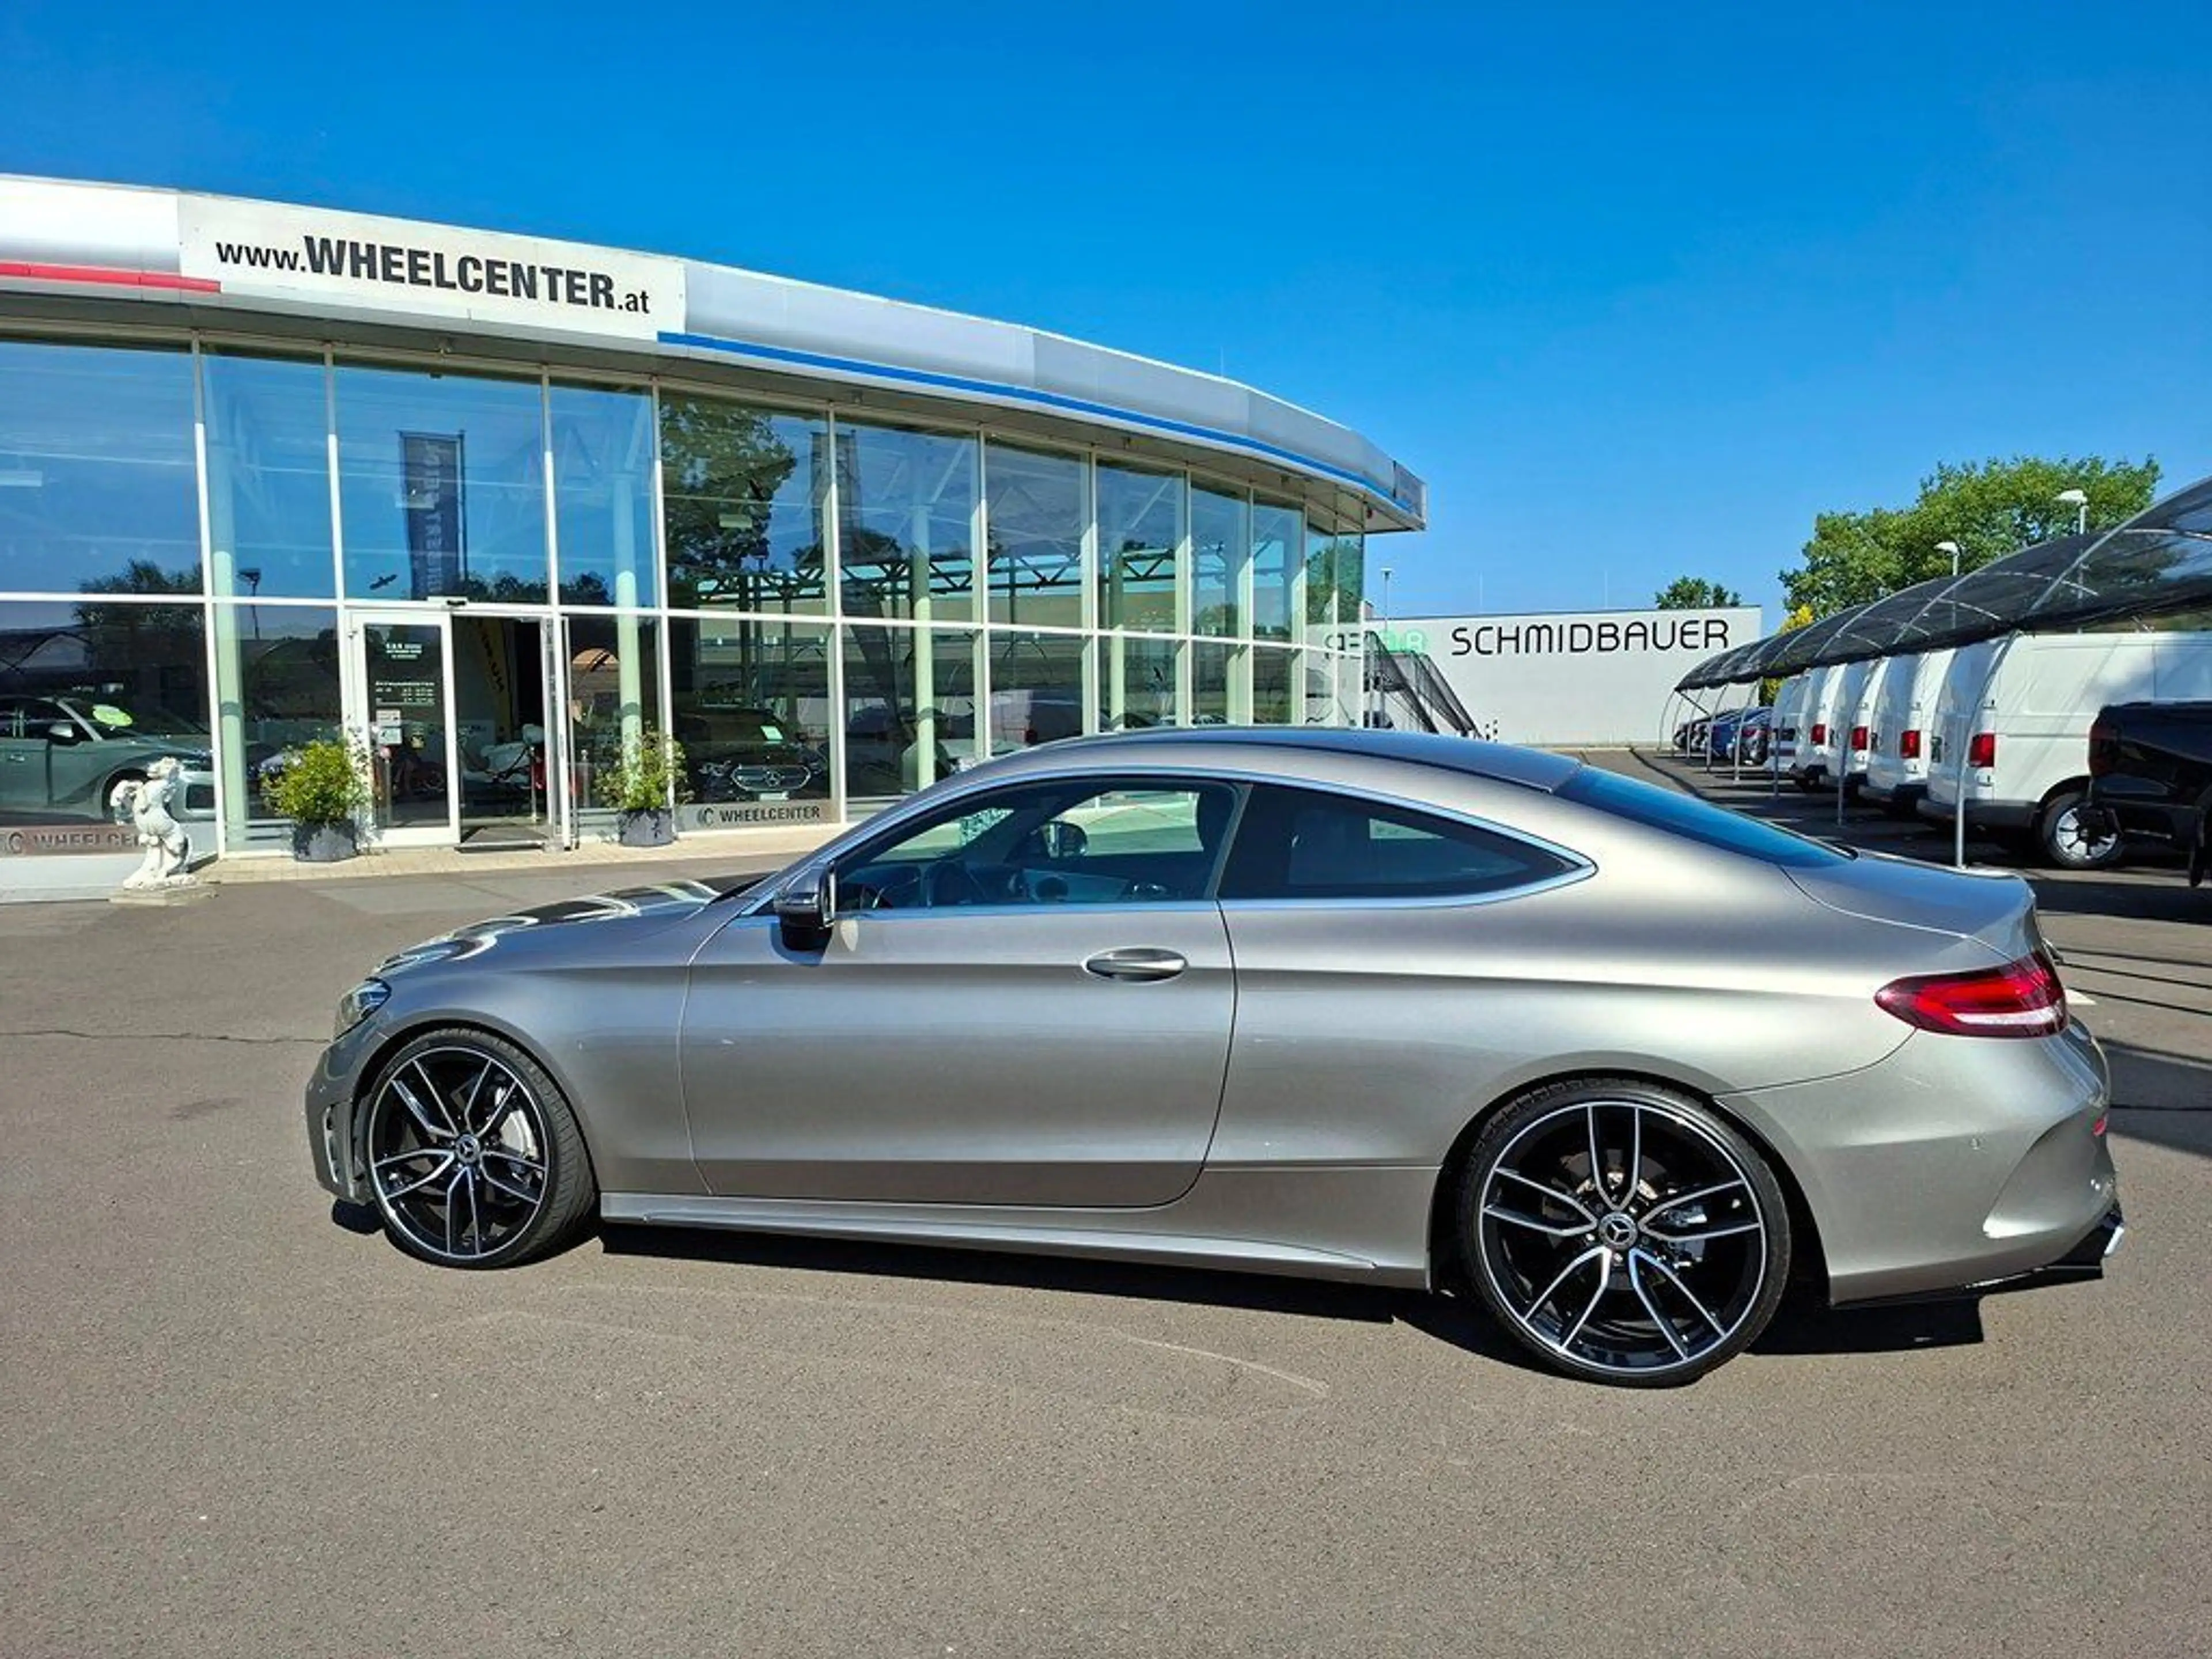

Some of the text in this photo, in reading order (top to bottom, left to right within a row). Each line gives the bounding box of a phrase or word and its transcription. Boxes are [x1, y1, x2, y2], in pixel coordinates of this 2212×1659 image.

[216, 235, 650, 314] www.WHEELCENTER.at
[1451, 619, 1729, 656] SCHMIDBAUER
[720, 805, 820, 823] WHEELCENTER
